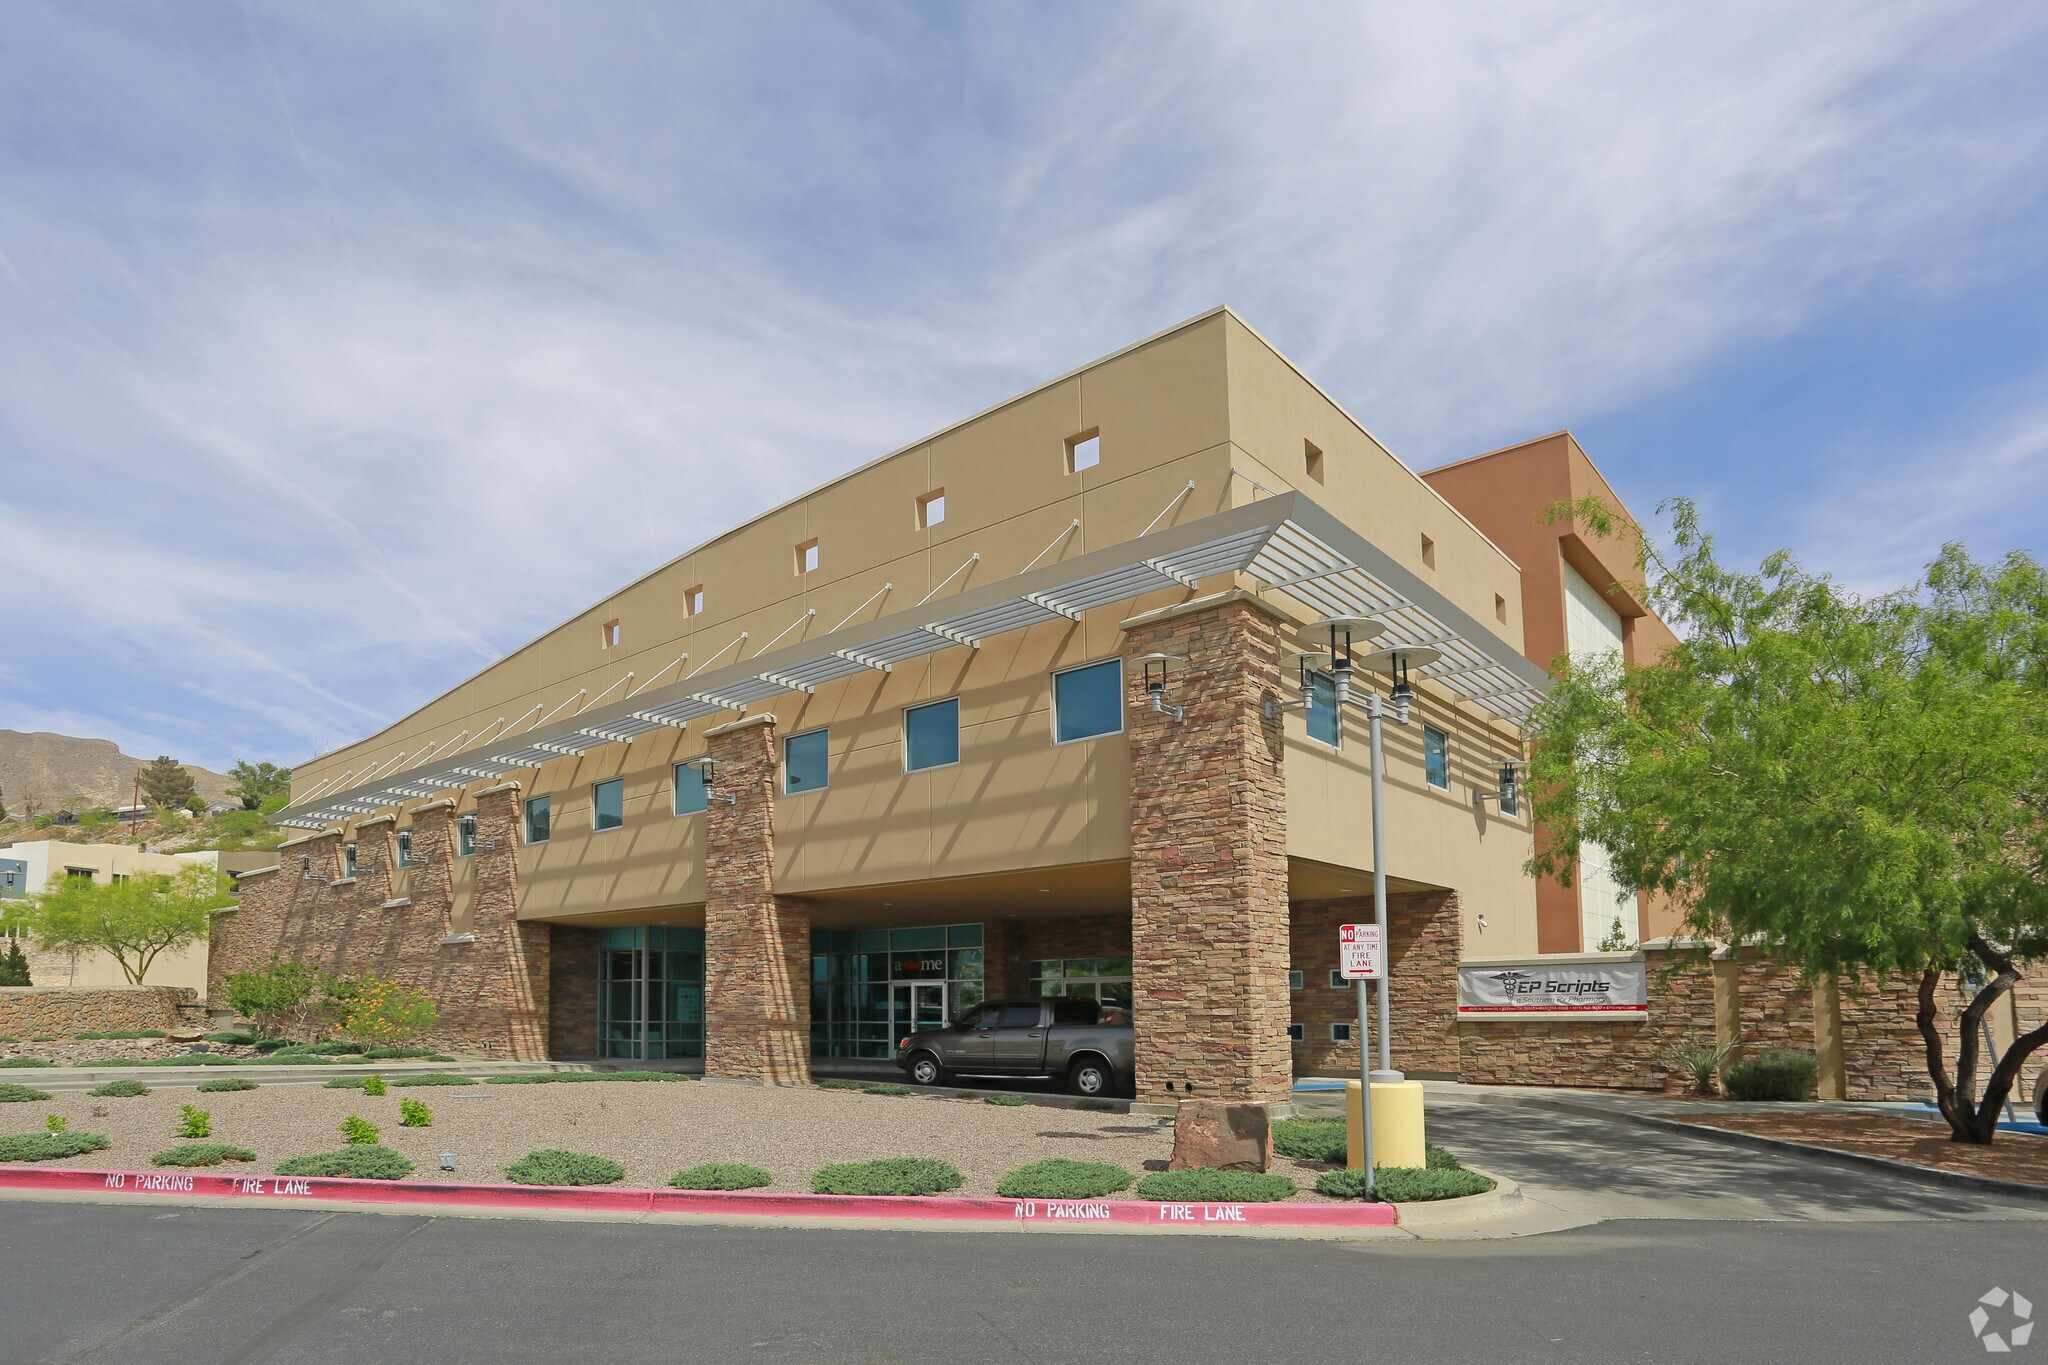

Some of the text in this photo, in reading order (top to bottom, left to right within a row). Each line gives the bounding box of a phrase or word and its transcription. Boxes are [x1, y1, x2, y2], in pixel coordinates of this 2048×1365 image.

[1341, 930, 1354, 940] NO
[1517, 980, 1610, 996] EP Scripts
[1569, 996, 1607, 1004] Pharmacy
[105, 1173, 194, 1191] NO PARKING
[233, 1177, 313, 1195] FIRE LANE
[1015, 1202, 1110, 1219] NO PARKING
[1160, 1204, 1246, 1221] FIRE LANE
